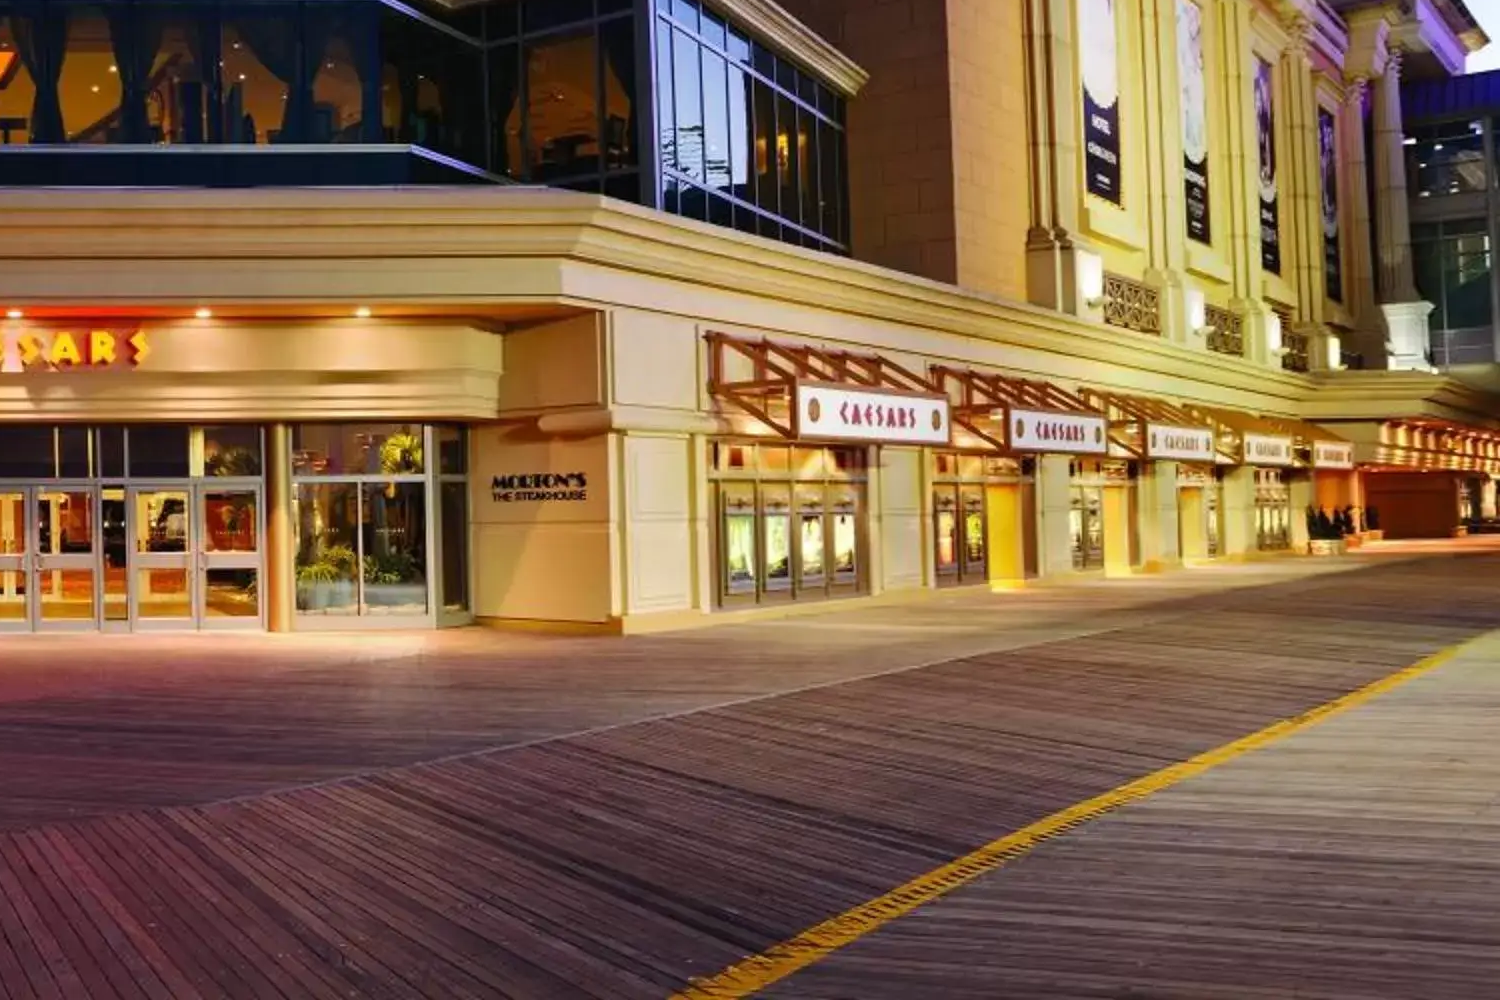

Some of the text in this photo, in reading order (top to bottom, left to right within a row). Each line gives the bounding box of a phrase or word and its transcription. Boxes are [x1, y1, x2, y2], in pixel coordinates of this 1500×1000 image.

[839, 400, 916, 428] CAESARS
[1035, 421, 1086, 441] CAESARS
[491, 472, 587, 488] MORTON'S
[492, 490, 587, 502] THE STEAKHOUSE
